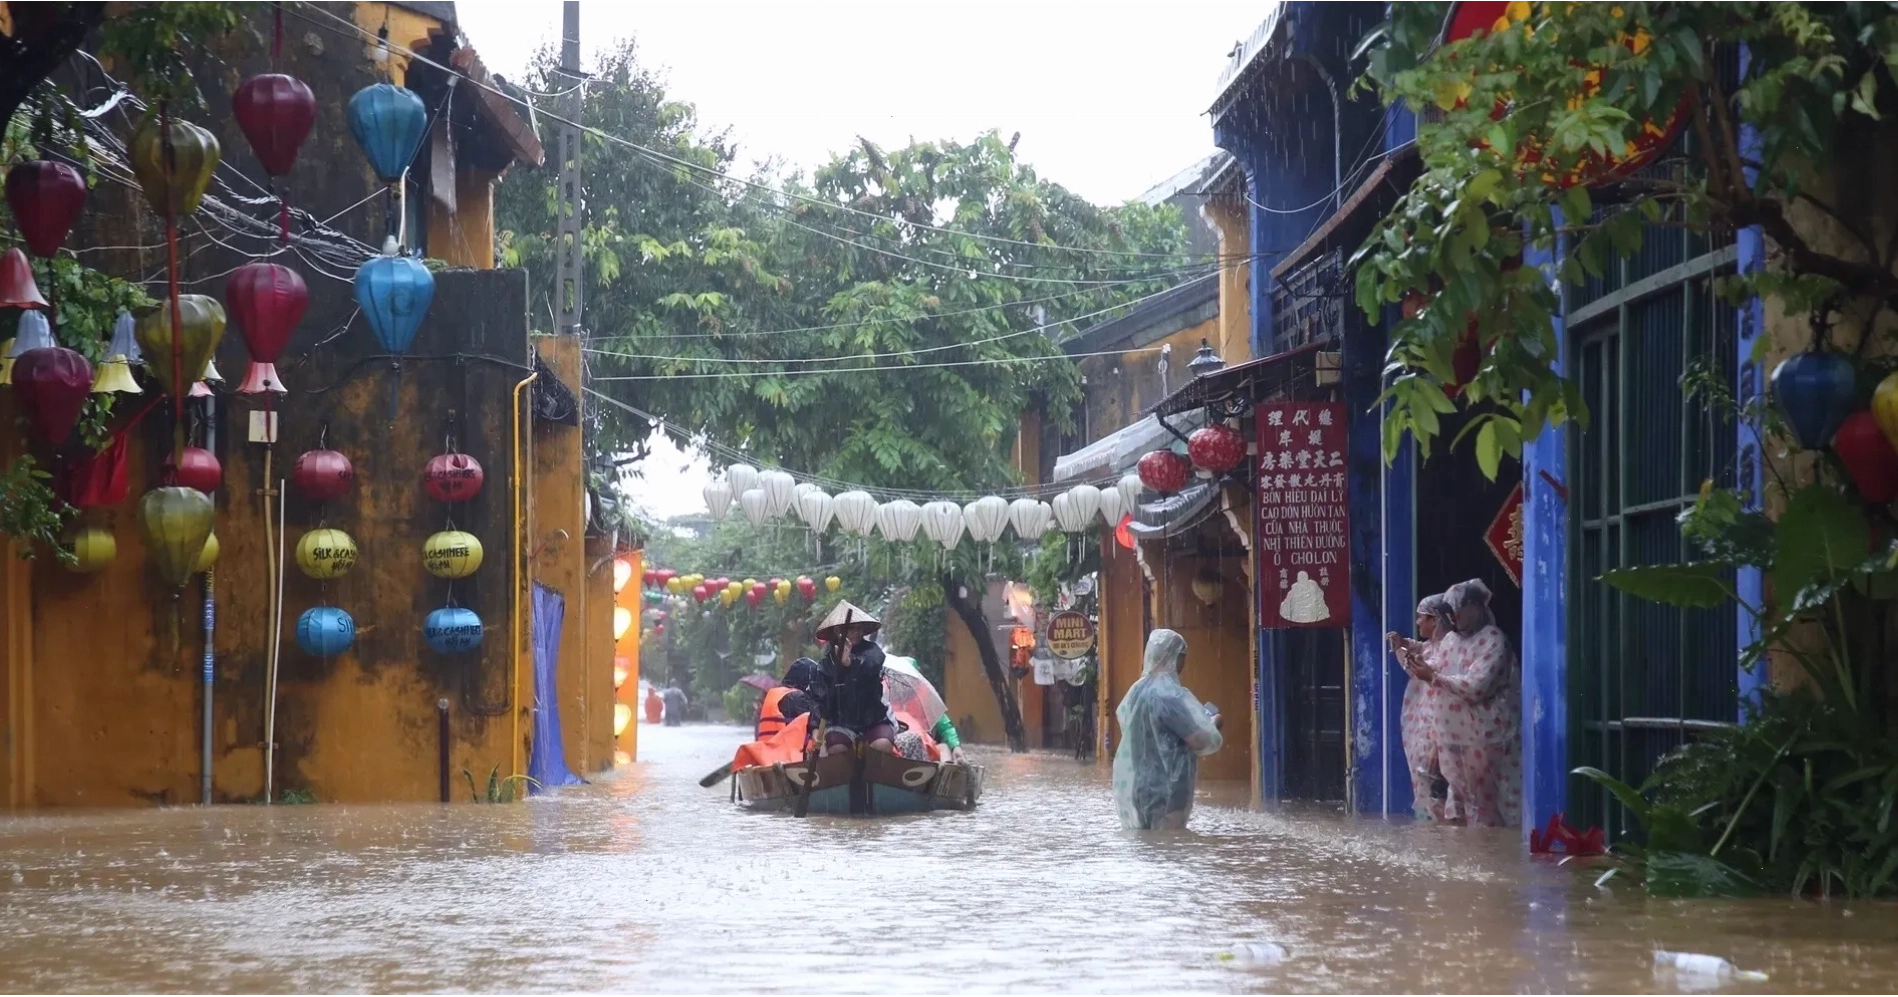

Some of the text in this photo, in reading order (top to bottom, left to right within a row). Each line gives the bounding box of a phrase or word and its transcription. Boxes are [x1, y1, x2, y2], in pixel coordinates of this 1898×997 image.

[1261, 506, 1280, 520] CAO
[1290, 551, 1337, 565] CHOLON
[1055, 617, 1084, 629] MINI
[1053, 627, 1087, 640] MART
